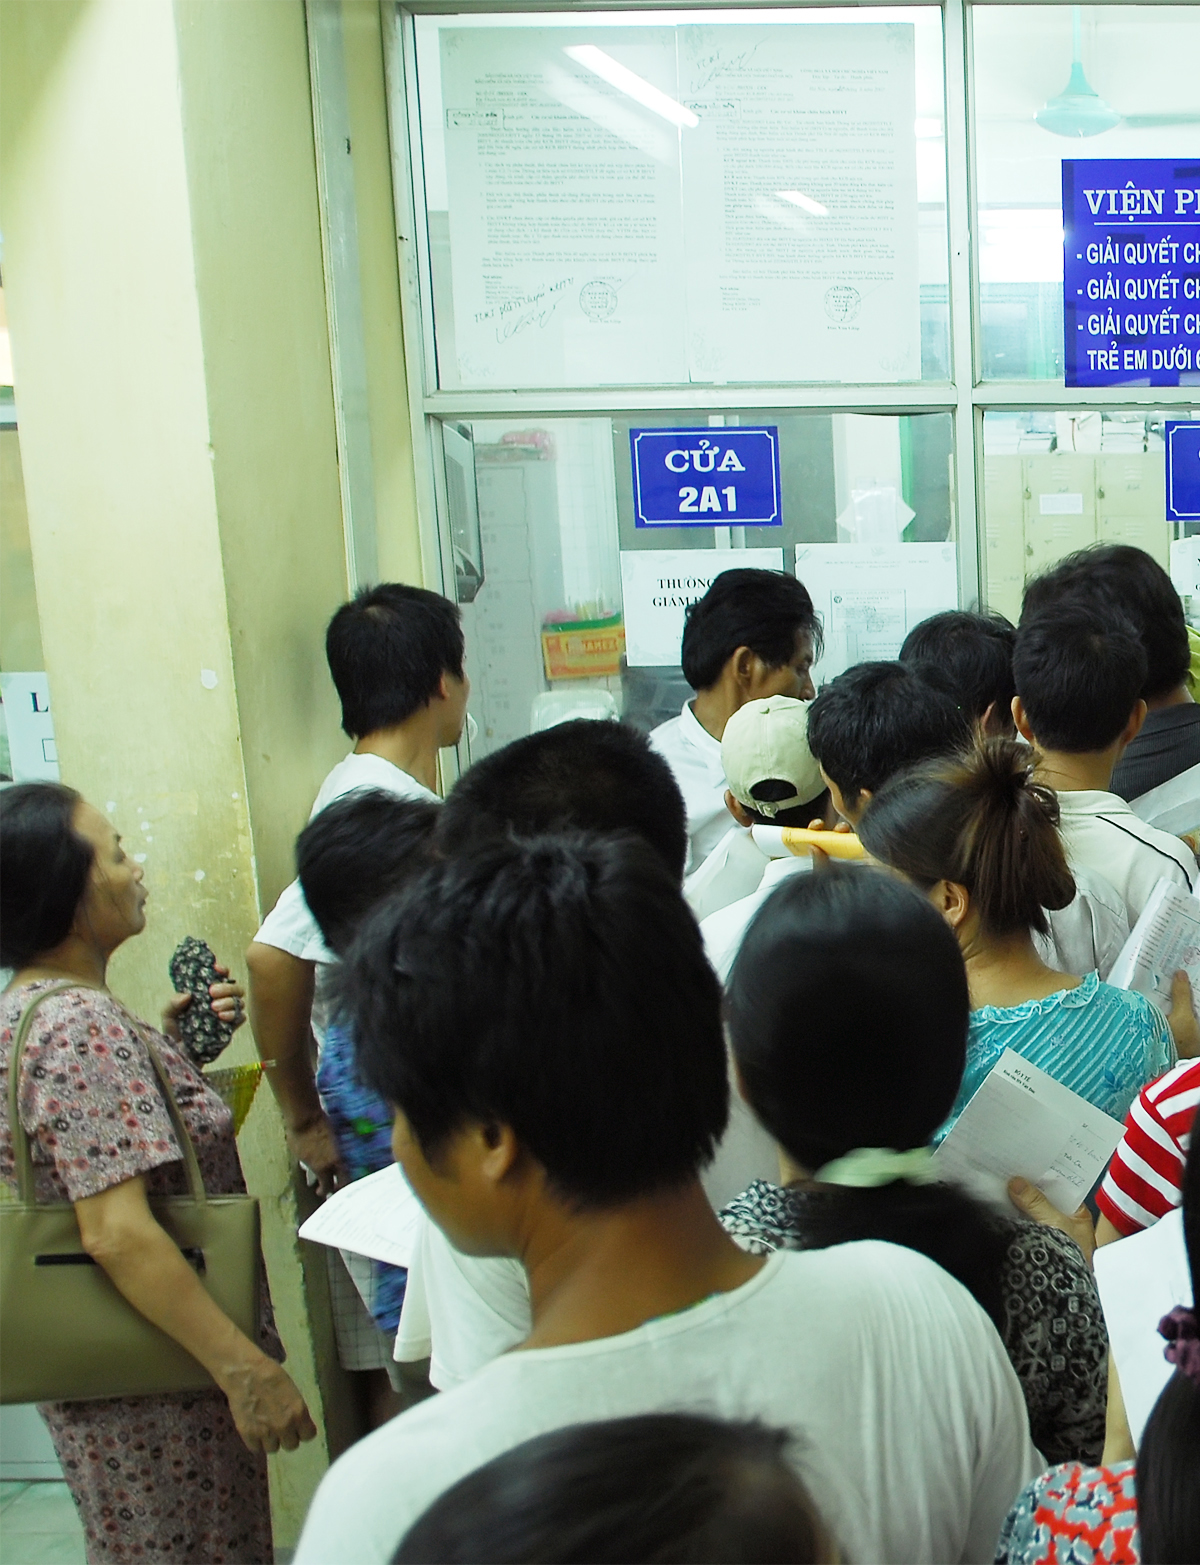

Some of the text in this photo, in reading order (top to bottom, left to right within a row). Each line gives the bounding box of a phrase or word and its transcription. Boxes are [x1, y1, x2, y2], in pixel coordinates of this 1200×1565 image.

[1083, 181, 1165, 221] VIỆN
[1086, 235, 1120, 264] GIẢI
[1123, 234, 1178, 265] QUYẾT
[1087, 271, 1120, 300] GIẢI
[1124, 270, 1179, 300] QUYẾT
[1087, 307, 1120, 335] GIẢI
[1124, 306, 1180, 336] QUYẾT
[1087, 341, 1119, 370] TRẺ
[1123, 349, 1147, 370] EM
[1152, 345, 1191, 370] DƯỚI
[665, 439, 746, 474] CỬA
[678, 486, 736, 513] 2A1
[653, 593, 689, 606] GIÁM
